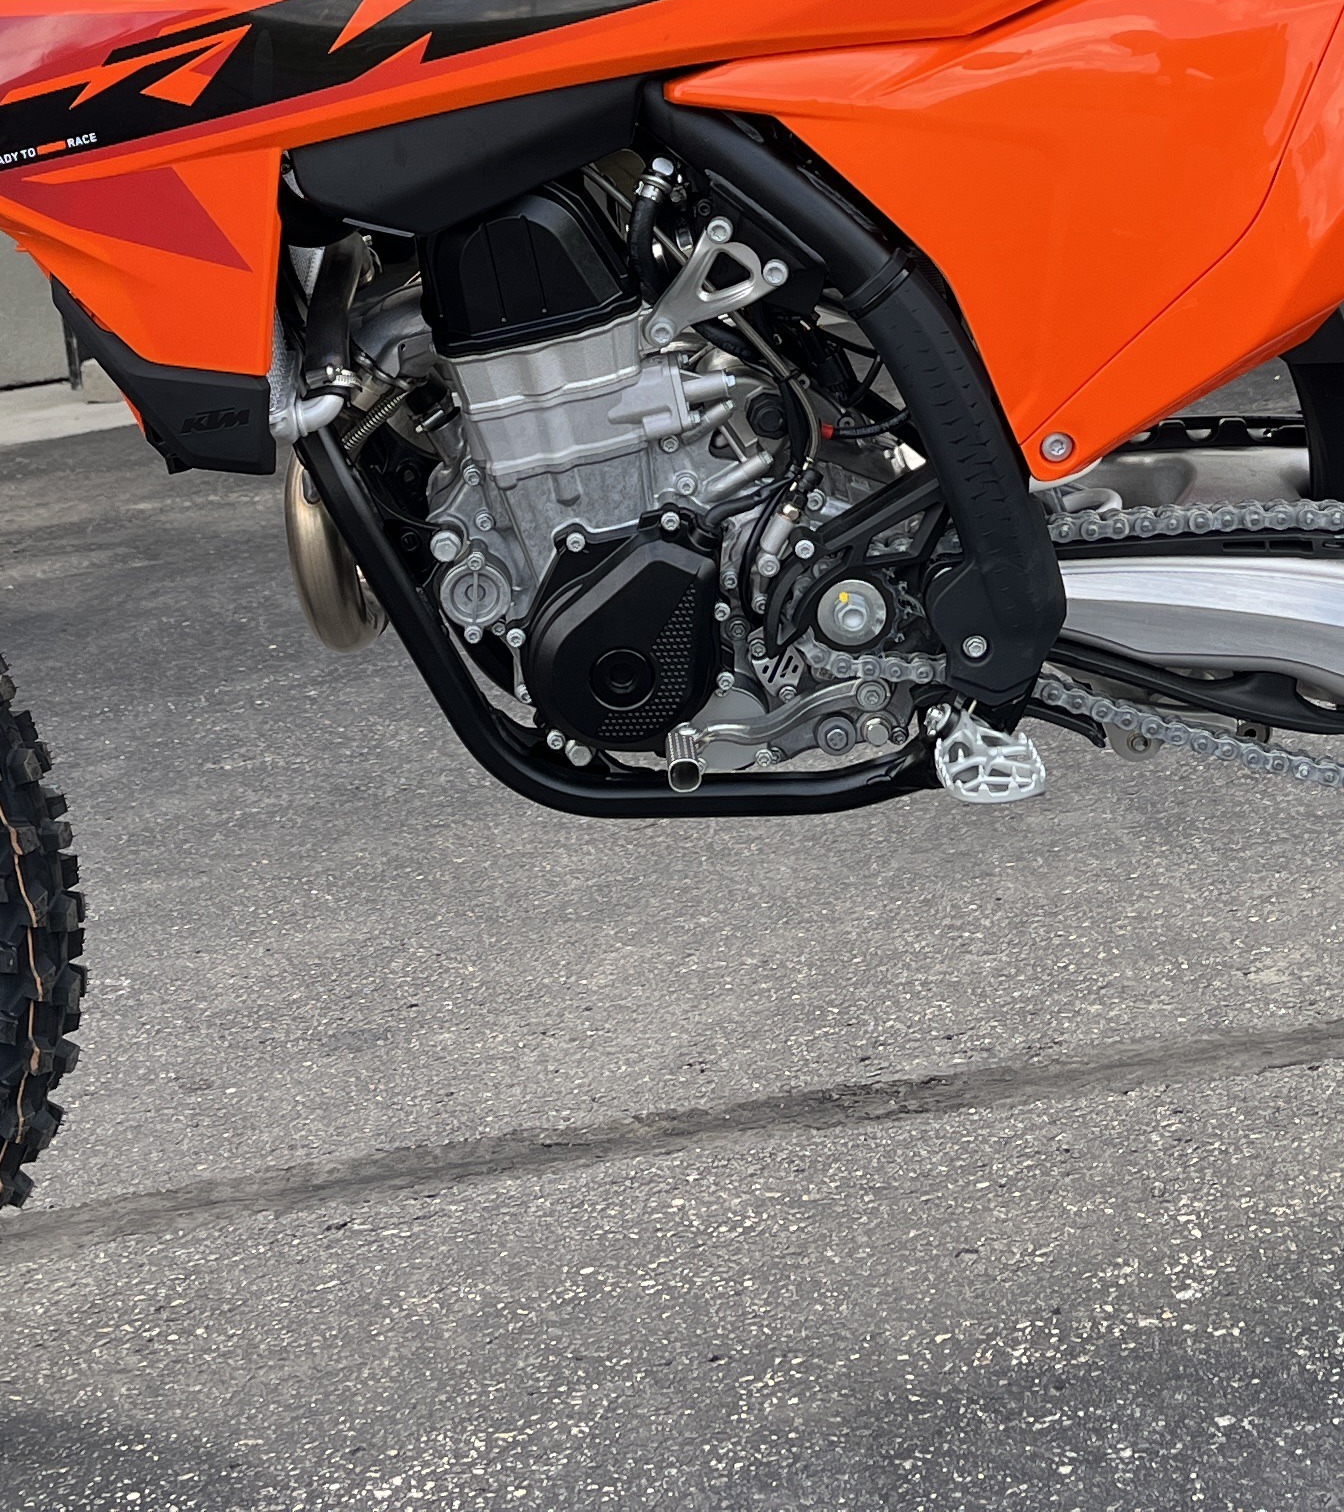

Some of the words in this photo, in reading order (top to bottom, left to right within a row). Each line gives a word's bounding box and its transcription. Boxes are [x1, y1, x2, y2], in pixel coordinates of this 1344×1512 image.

[19, 147, 36, 160] TO
[66, 132, 98, 148] RACE
[180, 407, 251, 435] KTM
